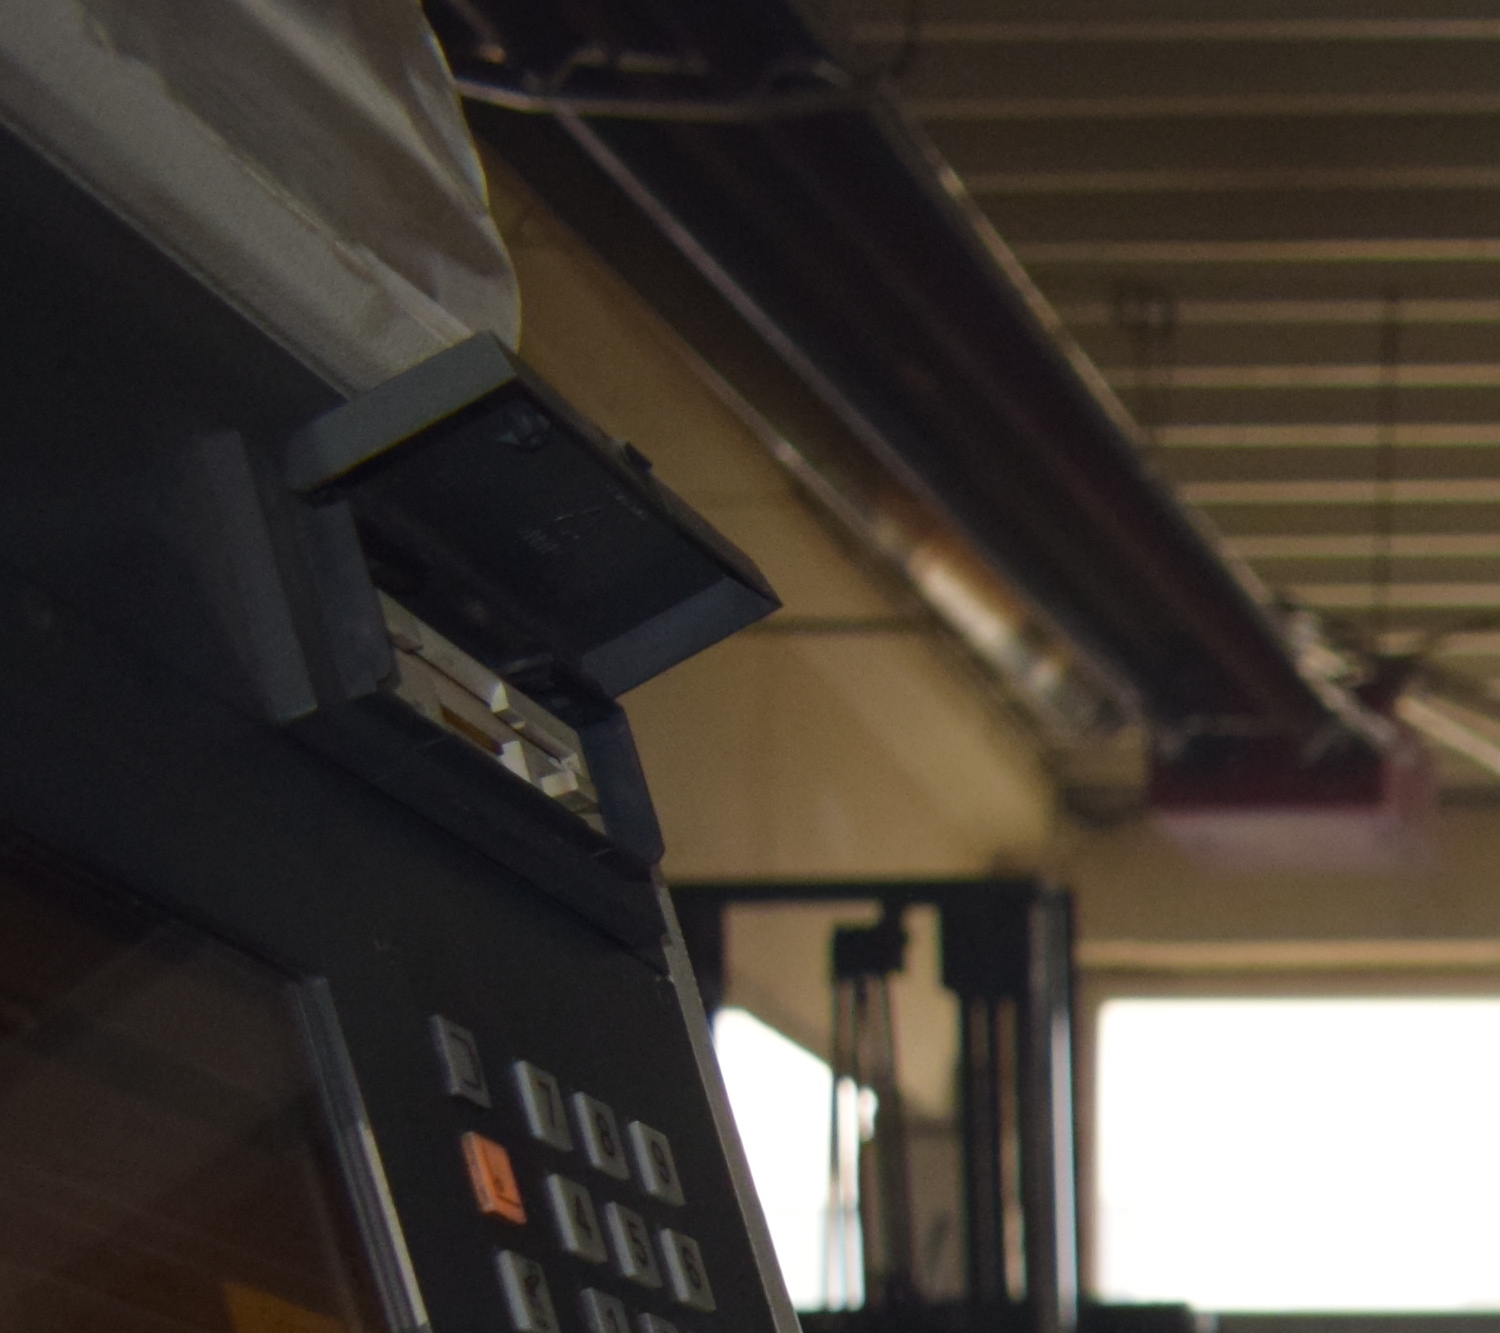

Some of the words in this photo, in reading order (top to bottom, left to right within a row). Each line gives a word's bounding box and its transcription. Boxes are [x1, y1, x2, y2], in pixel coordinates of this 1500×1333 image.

[594, 1111, 616, 1159] 8
[650, 1138, 672, 1186] 9
[627, 1218, 649, 1268] 5
[683, 1246, 705, 1291] 6
